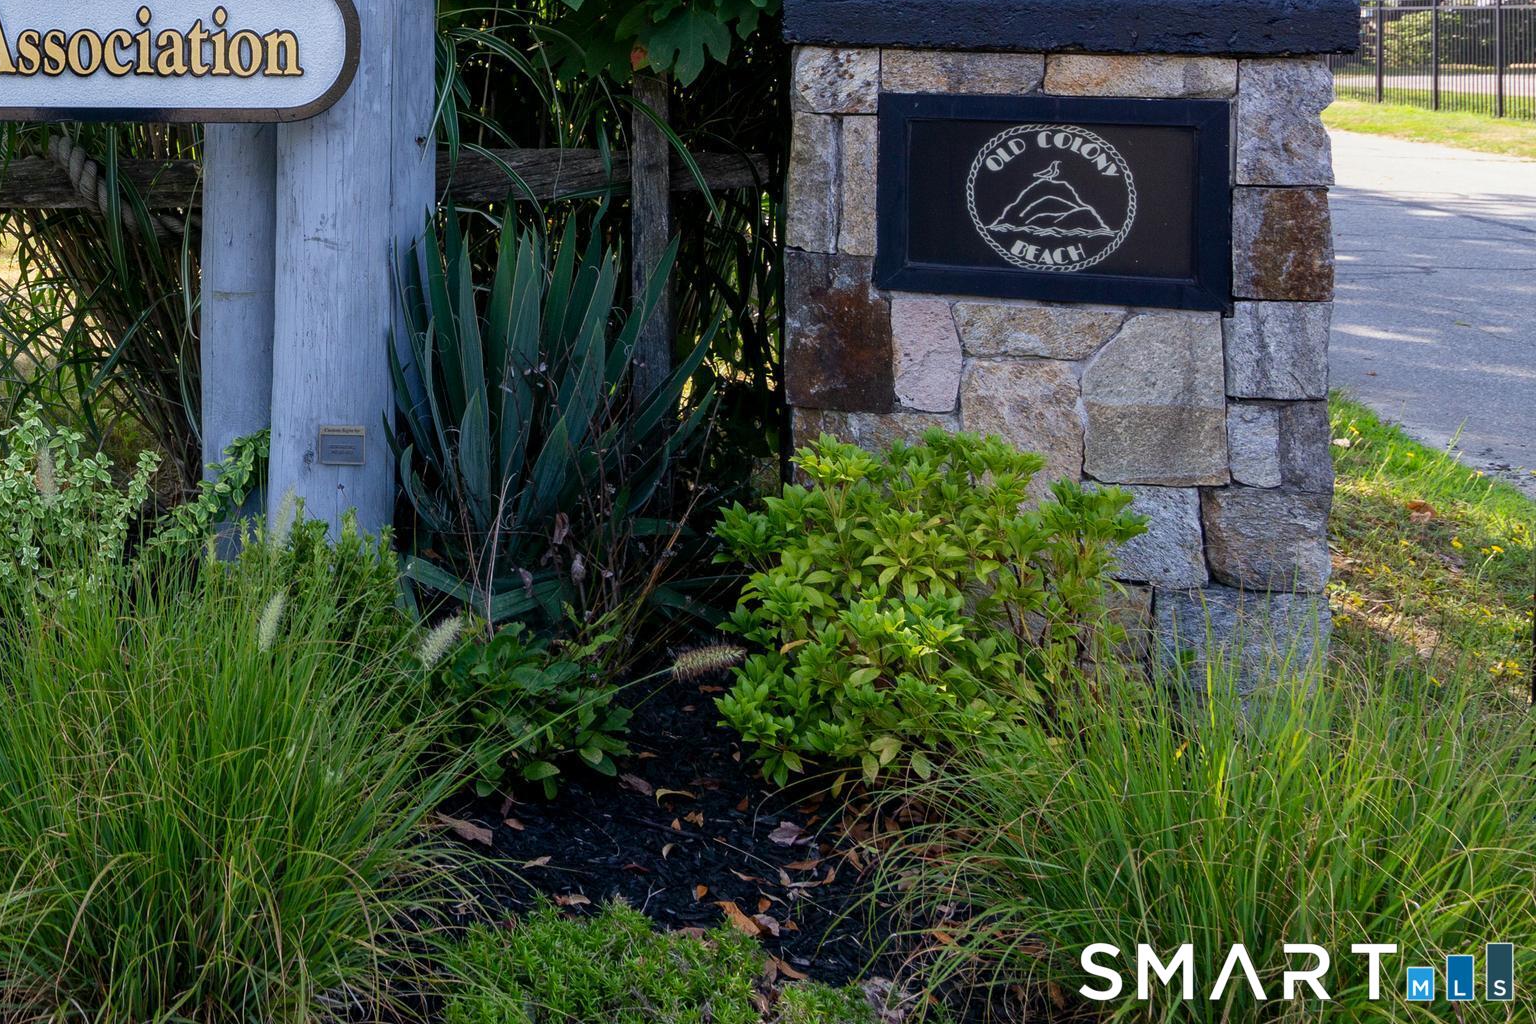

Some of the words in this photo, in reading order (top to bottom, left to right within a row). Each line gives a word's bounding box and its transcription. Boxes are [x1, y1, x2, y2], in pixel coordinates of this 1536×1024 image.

[985, 138, 1026, 172] OLD
[1037, 131, 1120, 176] COLONY
[1010, 240, 1087, 265] BEACH
